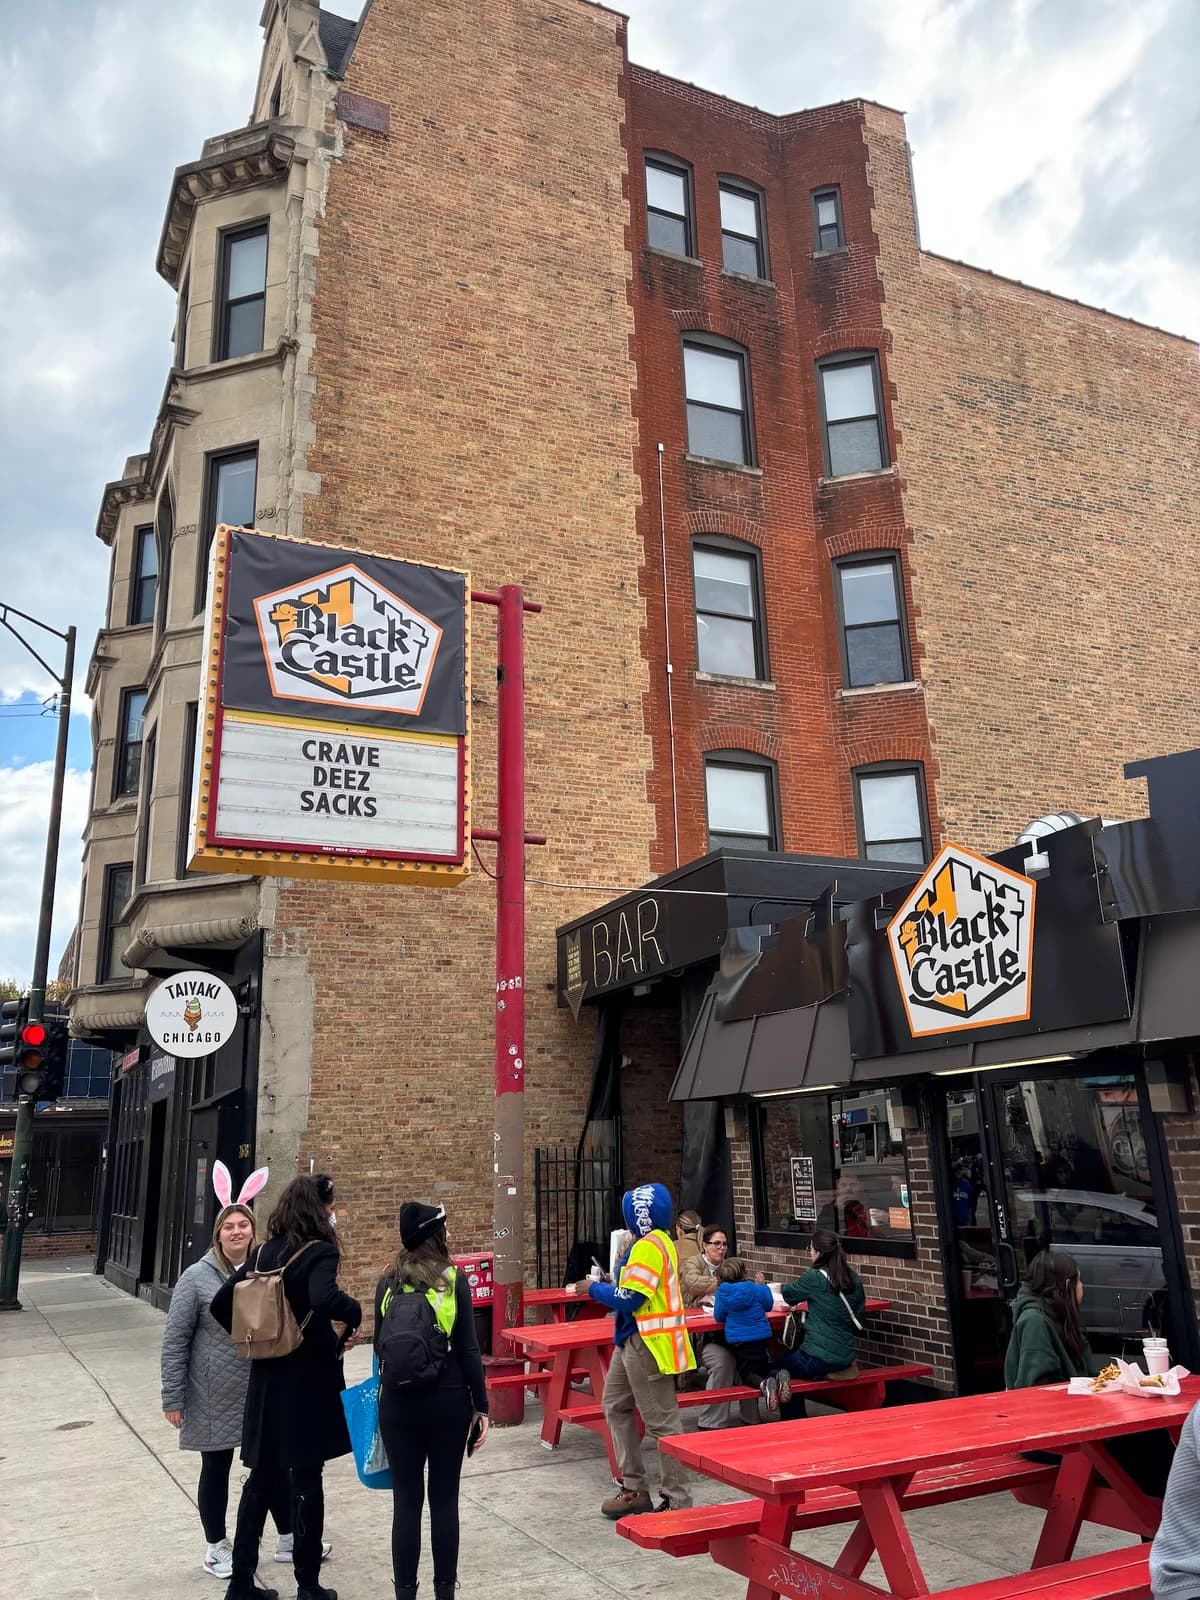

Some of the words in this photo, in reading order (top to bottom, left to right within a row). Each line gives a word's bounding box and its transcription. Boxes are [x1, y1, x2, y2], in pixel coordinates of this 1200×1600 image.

[274, 599, 410, 654] Black
[281, 628, 418, 686] Castle
[302, 739, 380, 768] CRAVE
[313, 765, 371, 792] DEEZ
[300, 790, 377, 817] SACKS
[904, 889, 1010, 951] Black
[592, 898, 665, 988] BAR
[165, 981, 222, 1000] TAIYAKI
[911, 942, 1020, 999] Castle
[163, 1032, 221, 1043] CHICAGO
